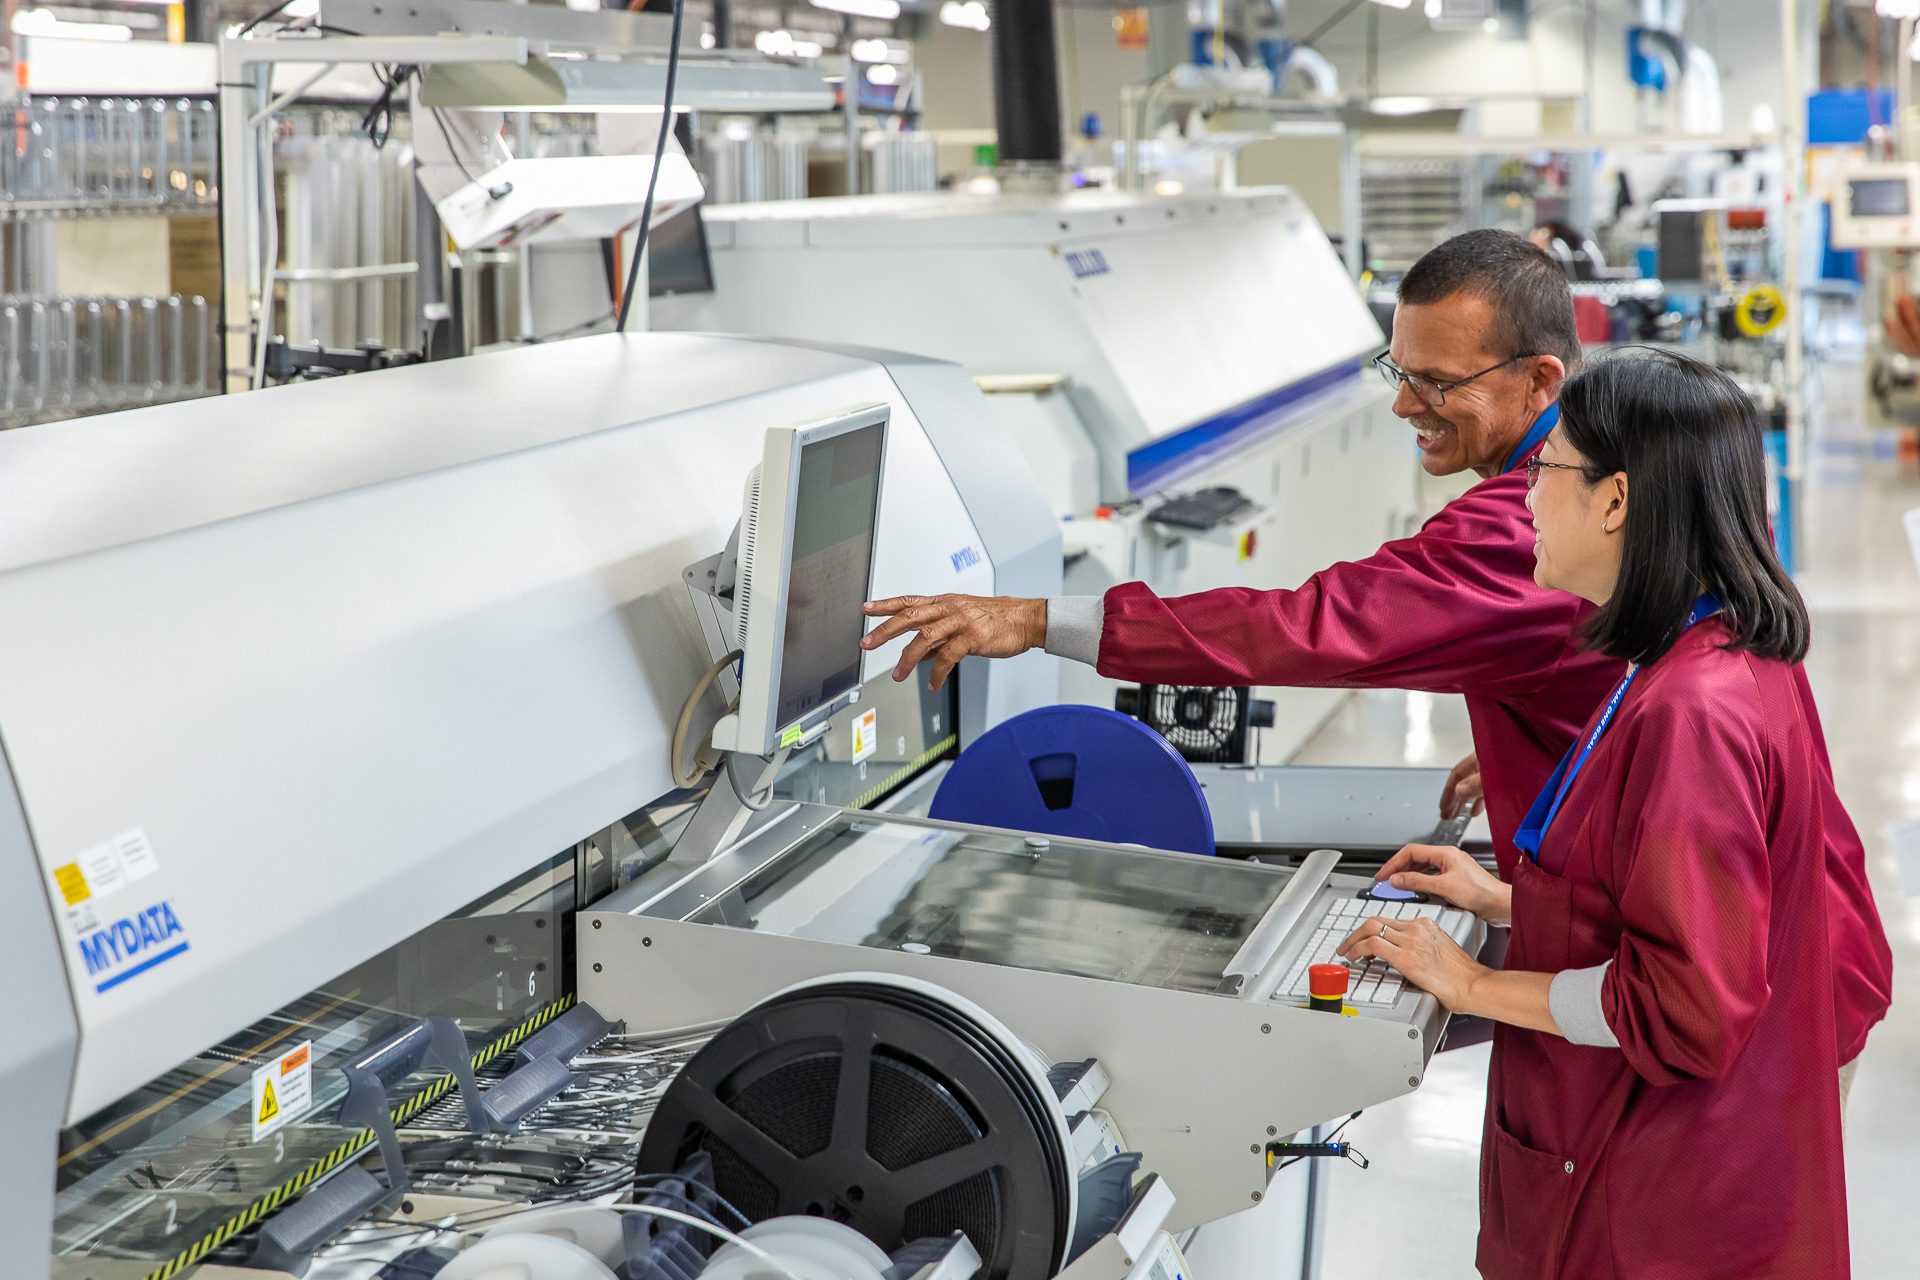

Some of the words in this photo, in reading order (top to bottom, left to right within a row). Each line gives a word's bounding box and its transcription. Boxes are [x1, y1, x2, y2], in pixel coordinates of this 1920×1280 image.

[1600, 705, 1613, 727] ONE
[1586, 724, 1602, 750] GOAL
[79, 901, 184, 975] MYDATA
[528, 970, 536, 997] 6
[275, 1131, 285, 1163] 3
[165, 1199, 178, 1235] 2
